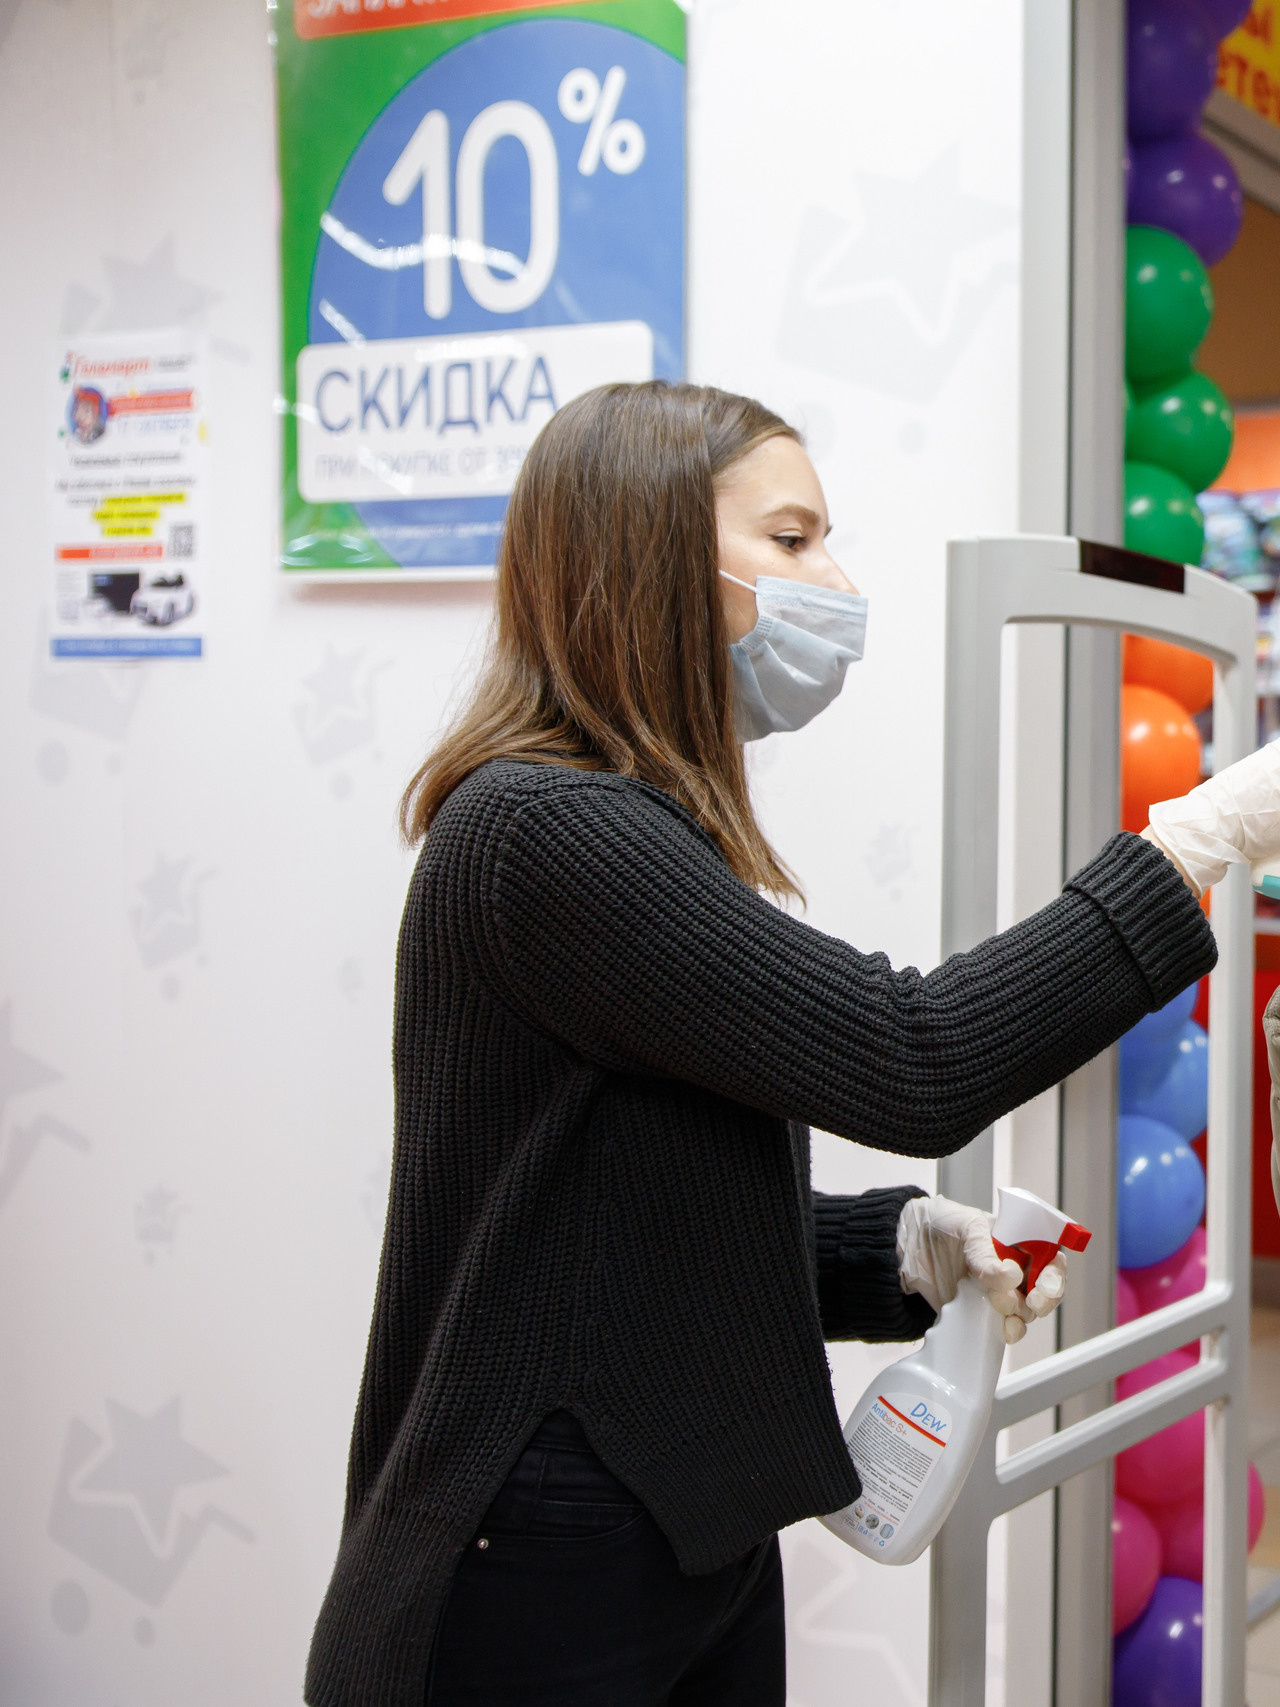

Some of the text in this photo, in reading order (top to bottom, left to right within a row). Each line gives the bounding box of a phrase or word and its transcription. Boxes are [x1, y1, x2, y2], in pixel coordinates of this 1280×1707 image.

[382, 65, 645, 320] 10%
[314, 355, 559, 435] СКИДКА
[315, 453, 357, 481] ПРИ
[458, 447, 487, 476] ОТ
[871, 1403, 908, 1436] Antibac S+
[910, 1402, 947, 1432] DEW
